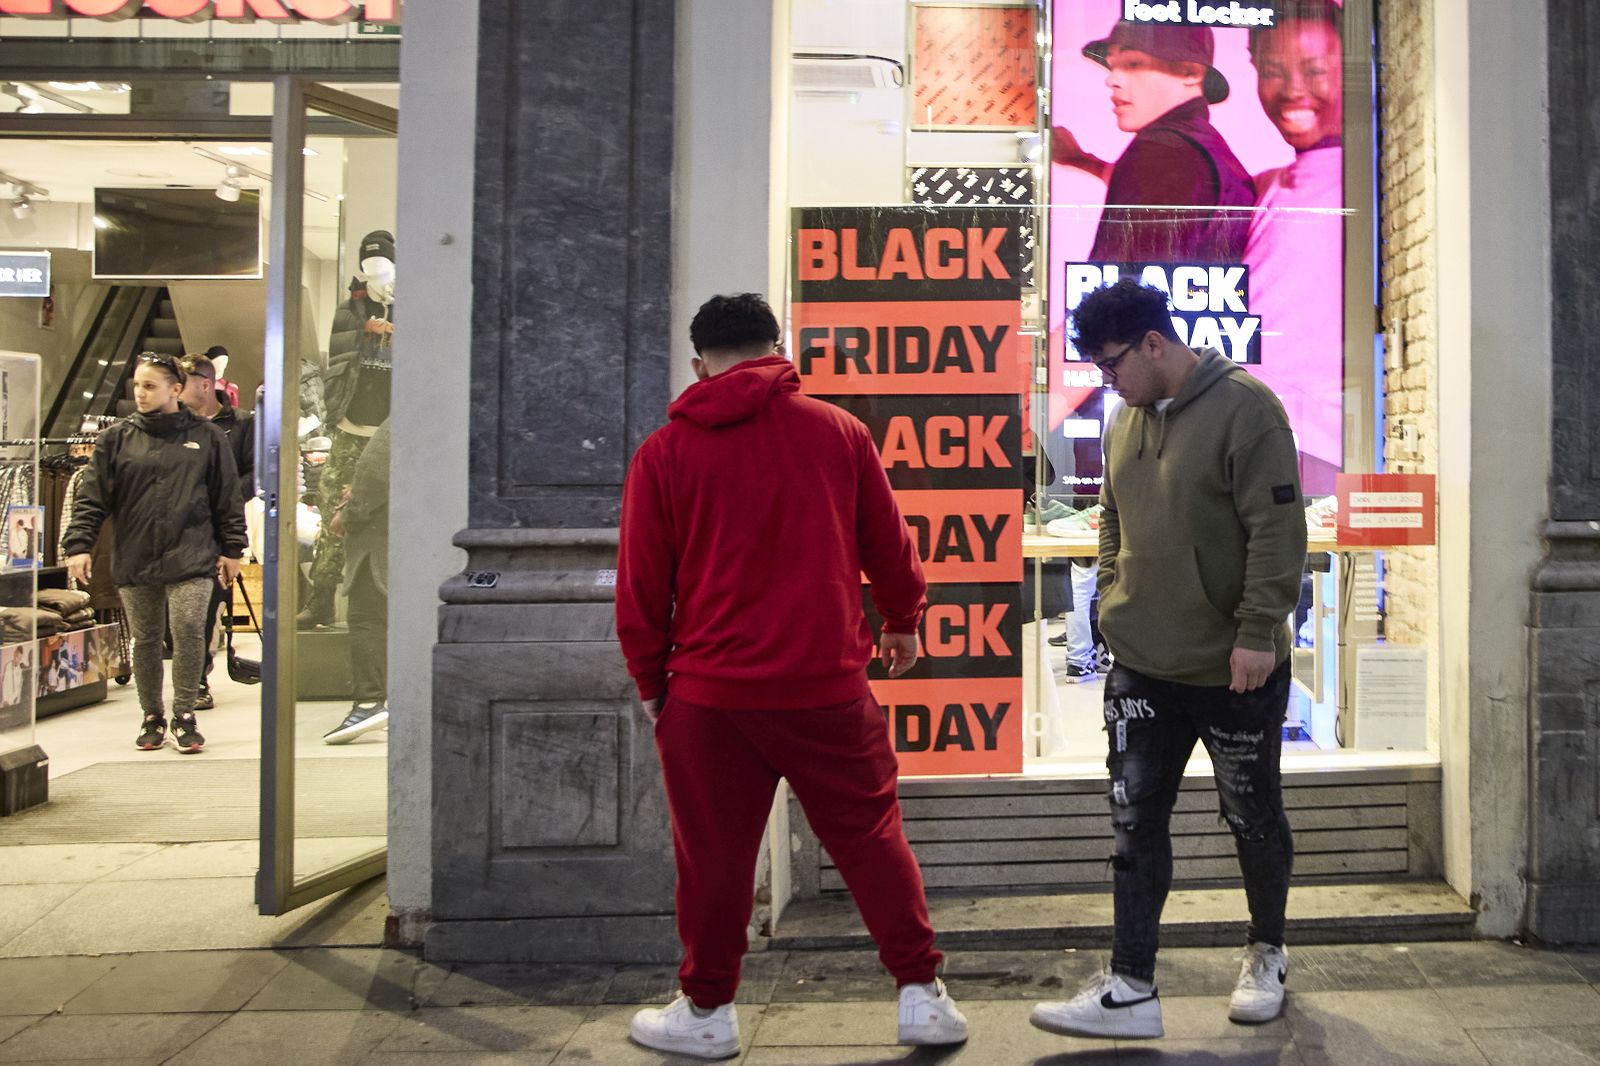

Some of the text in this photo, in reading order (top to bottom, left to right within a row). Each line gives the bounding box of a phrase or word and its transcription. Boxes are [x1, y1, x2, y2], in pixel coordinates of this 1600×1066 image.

[1124, 0, 1274, 26] Foot Locker
[17, 268, 43, 282] HER
[798, 228, 1011, 281] BLACK
[1066, 264, 1248, 313] BCK
[800, 325, 1010, 375] FRIDAY
[881, 415, 1012, 468] ACK
[903, 513, 1011, 563] DAY
[880, 702, 1011, 753] DAY
